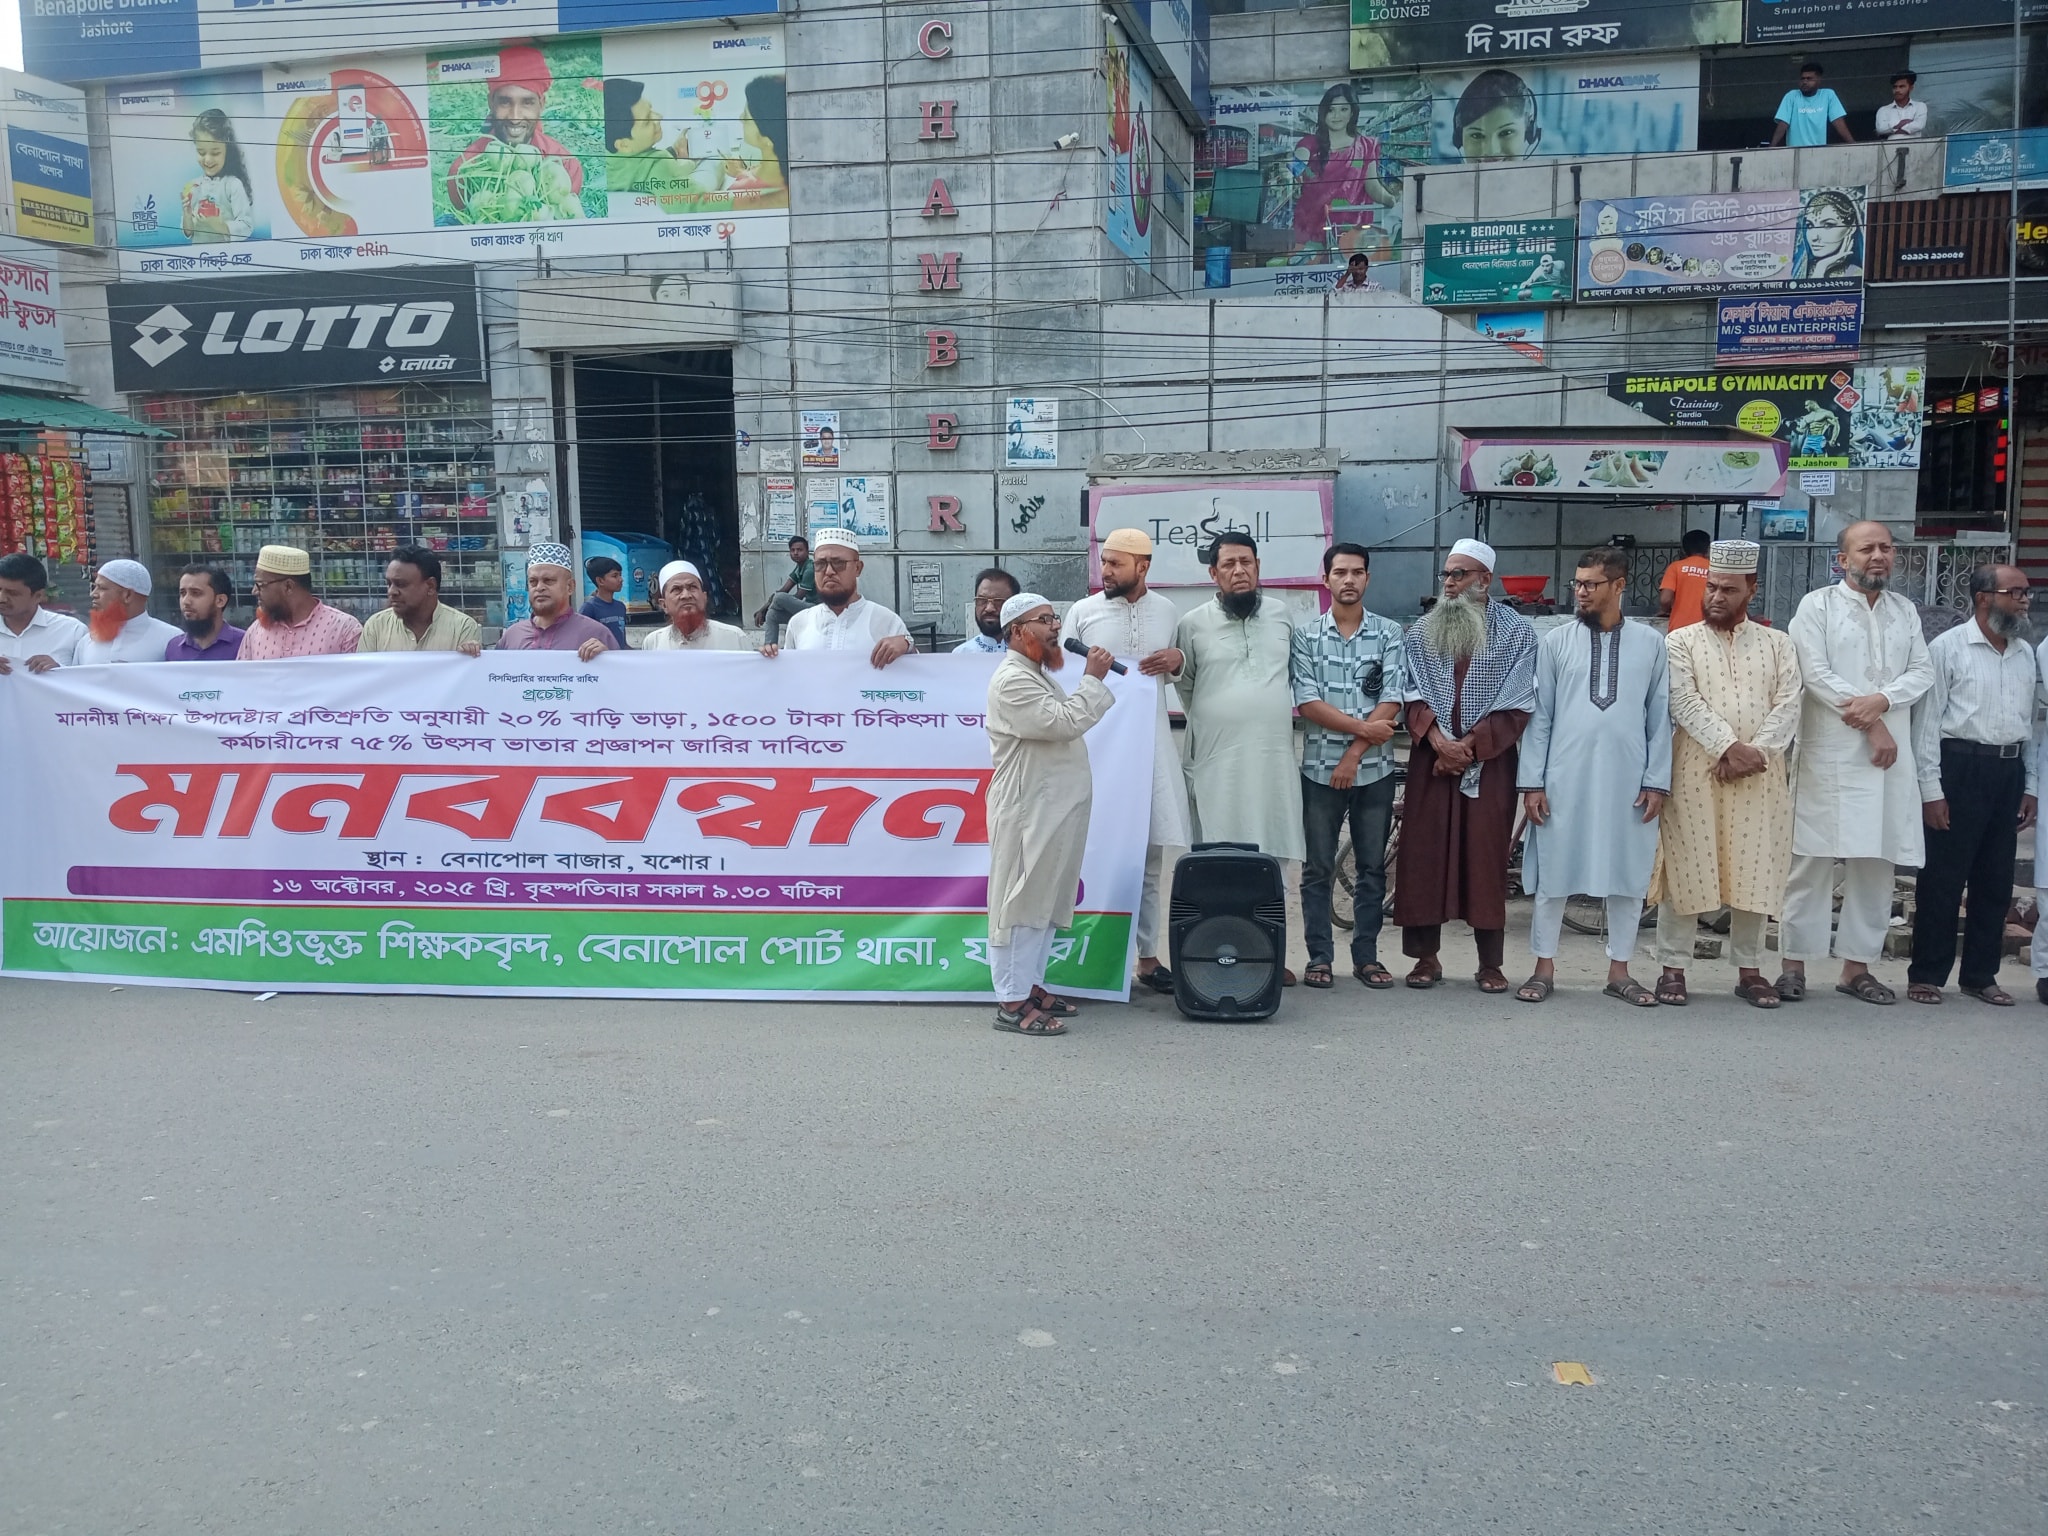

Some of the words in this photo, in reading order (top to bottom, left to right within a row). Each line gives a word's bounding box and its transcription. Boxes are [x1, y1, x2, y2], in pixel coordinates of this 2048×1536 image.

[1369, 5, 1430, 21] LOUNGE
[1774, 3, 1841, 16] Smartphone
[80, 19, 133, 38] Jashore
[1465, 23, 1494, 54] দি
[1500, 28, 1552, 51] সান
[1560, 22, 1621, 47] রুফ
[15, 142, 60, 164] বেনাপোল
[63, 154, 84, 169] শাখা
[39, 164, 63, 178] যশোর
[670, 178, 689, 190] সেবা
[634, 195, 657, 207] এখন
[35, 209, 60, 220] UNION
[658, 226, 680, 239] ঢাকা
[682, 223, 712, 237] ব্যাংক
[1471, 224, 1527, 237] BENAPOLE
[470, 234, 494, 248] ঢাকা
[496, 232, 525, 247] ব্যাংক
[301, 247, 321, 261] ঢাকা
[324, 246, 352, 260] ব্যাংক
[356, 241, 388, 257] eRin
[140, 259, 163, 272] ঢাকা
[167, 257, 196, 271] ব্যাংক
[231, 253, 252, 265] চেক
[917, 19, 966, 532] CHAMBER
[1275, 271, 1303, 285] ঢাকা
[1308, 269, 1344, 284] ব্যাংক
[1590, 289, 1612, 298] রহমান
[1667, 284, 1691, 294] দোকান
[1728, 281, 1759, 291] বেনাপোল
[201, 301, 455, 356] LOTTO
[1721, 325, 1745, 335] M/S.
[1748, 324, 1777, 334] SIAM
[1781, 322, 1856, 333] ENTERPRISE
[1626, 376, 1717, 394] BENAPOLE
[1722, 374, 1829, 392] GYMNACITY
[1670, 396, 1723, 411] Training
[1676, 419, 1709, 427] Strength
[1677, 411, 1702, 419] Cardio
[576, 674, 599, 684] রাহিম
[178, 689, 224, 702] একতা
[522, 686, 573, 702] প্রচেষ্টা
[860, 689, 926, 703] সফলতা
[55, 707, 118, 727] মাননীয়
[126, 708, 178, 727] শিক্ষা
[184, 709, 282, 726] উপদেষ্টার
[289, 706, 393, 727] প্রতিশ্রুতি
[400, 706, 490, 729] অনুযায়ী
[498, 709, 562, 728] ২০%
[570, 708, 625, 729] বাড়ি
[707, 712, 777, 728] ১৫০০
[786, 708, 846, 728] টাকা
[851, 708, 949, 728] চিকিৎসা
[955, 712, 987, 730] ভা
[217, 731, 343, 751] কর্মচারীদের
[350, 733, 412, 752] ৭৫%
[422, 732, 496, 752] উৎসব
[502, 737, 578, 753] ভাতার
[585, 738, 675, 755] প্রজ্ঞাপন
[681, 735, 752, 754] জারির
[758, 735, 848, 755] দাবিতে
[107, 764, 990, 850] মানববন্ধন
[362, 850, 407, 870] স্থান
[440, 851, 548, 869] বেনাপোল
[554, 853, 634, 873] বাজার,
[641, 853, 712, 871] যশোর
[272, 878, 302, 894] ১৬
[414, 881, 476, 897] ২০২৫
[646, 883, 706, 899] সকাল
[712, 884, 771, 900] ৯.৩০
[777, 880, 844, 900] ঘটিকা
[578, 934, 749, 965] বেনাপোল
[761, 928, 845, 965] পোর্ট
[856, 936, 950, 970] থানা,
